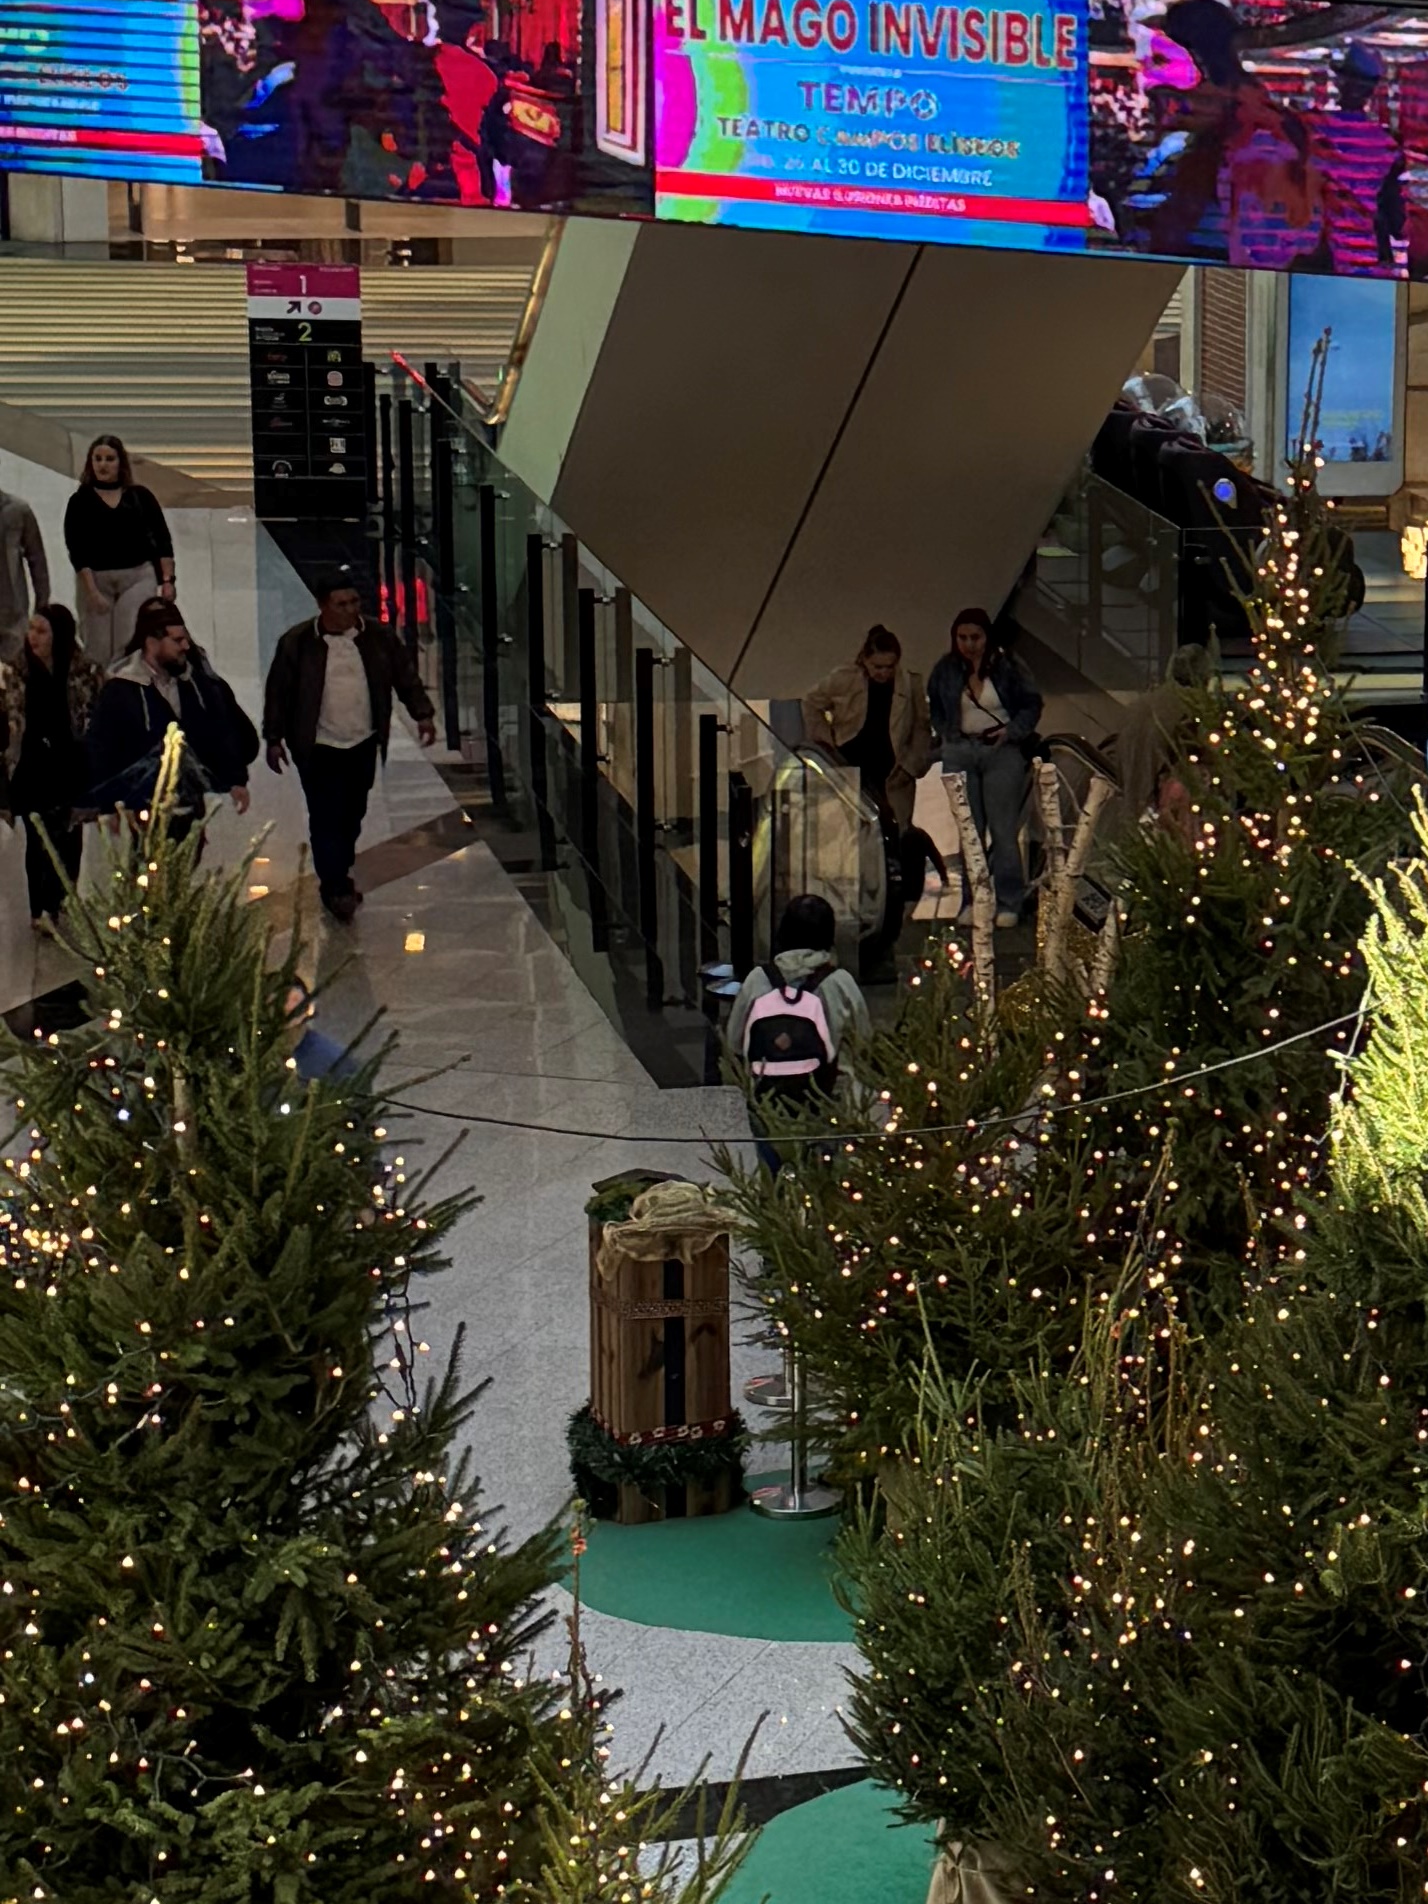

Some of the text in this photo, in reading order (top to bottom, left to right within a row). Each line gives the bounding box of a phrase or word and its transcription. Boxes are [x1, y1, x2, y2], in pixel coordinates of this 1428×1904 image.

[869, 1, 1077, 69] INVISIBLE
[797, 80, 938, 120] TEMPO
[717, 116, 810, 142] TEATRO
[838, 158, 860, 175] 30
[865, 161, 888, 177] DE
[893, 162, 993, 187] DICIEMBRE
[298, 321, 313, 342] 2
